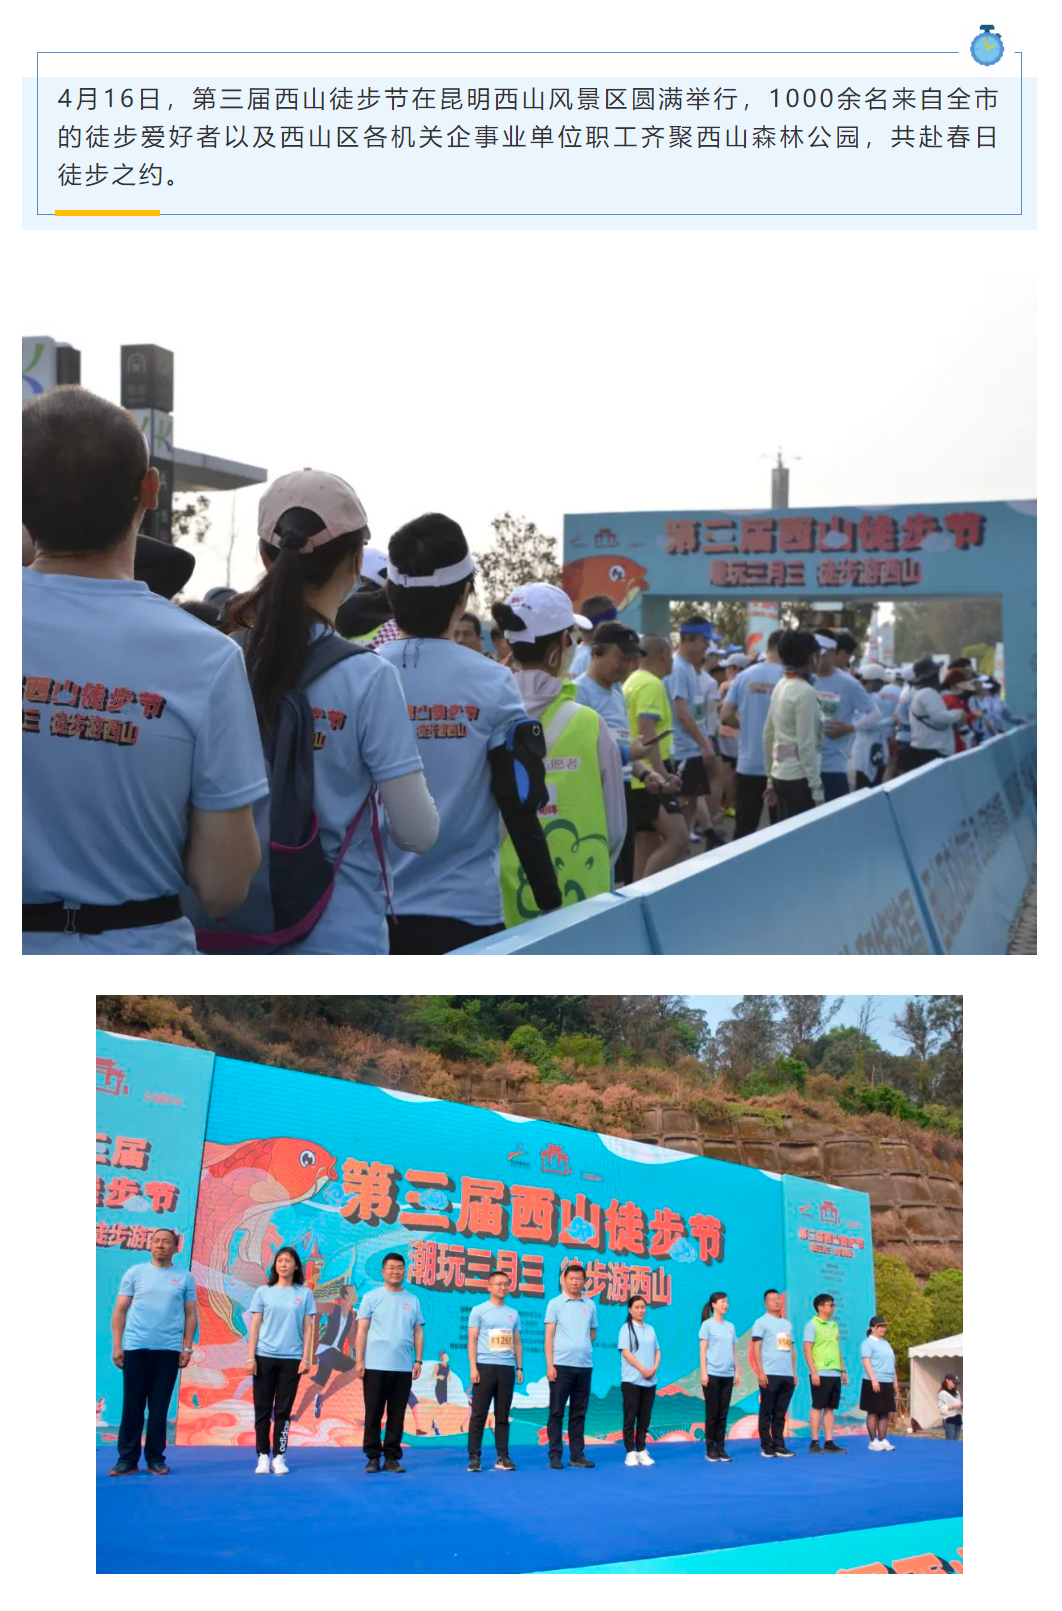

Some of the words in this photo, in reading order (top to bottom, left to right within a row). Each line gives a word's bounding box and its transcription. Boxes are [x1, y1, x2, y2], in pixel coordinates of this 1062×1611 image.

[663, 510, 986, 556] 第三届西山徒步节
[709, 558, 806, 590] 潮玩三月三
[817, 556, 923, 590] 徒步游西山
[50, 711, 140, 746] 徒步游西山
[96, 1174, 181, 1214] 步节
[340, 1157, 724, 1265] 第三届西山徒步节
[406, 1238, 546, 1298] 潮玩三月三
